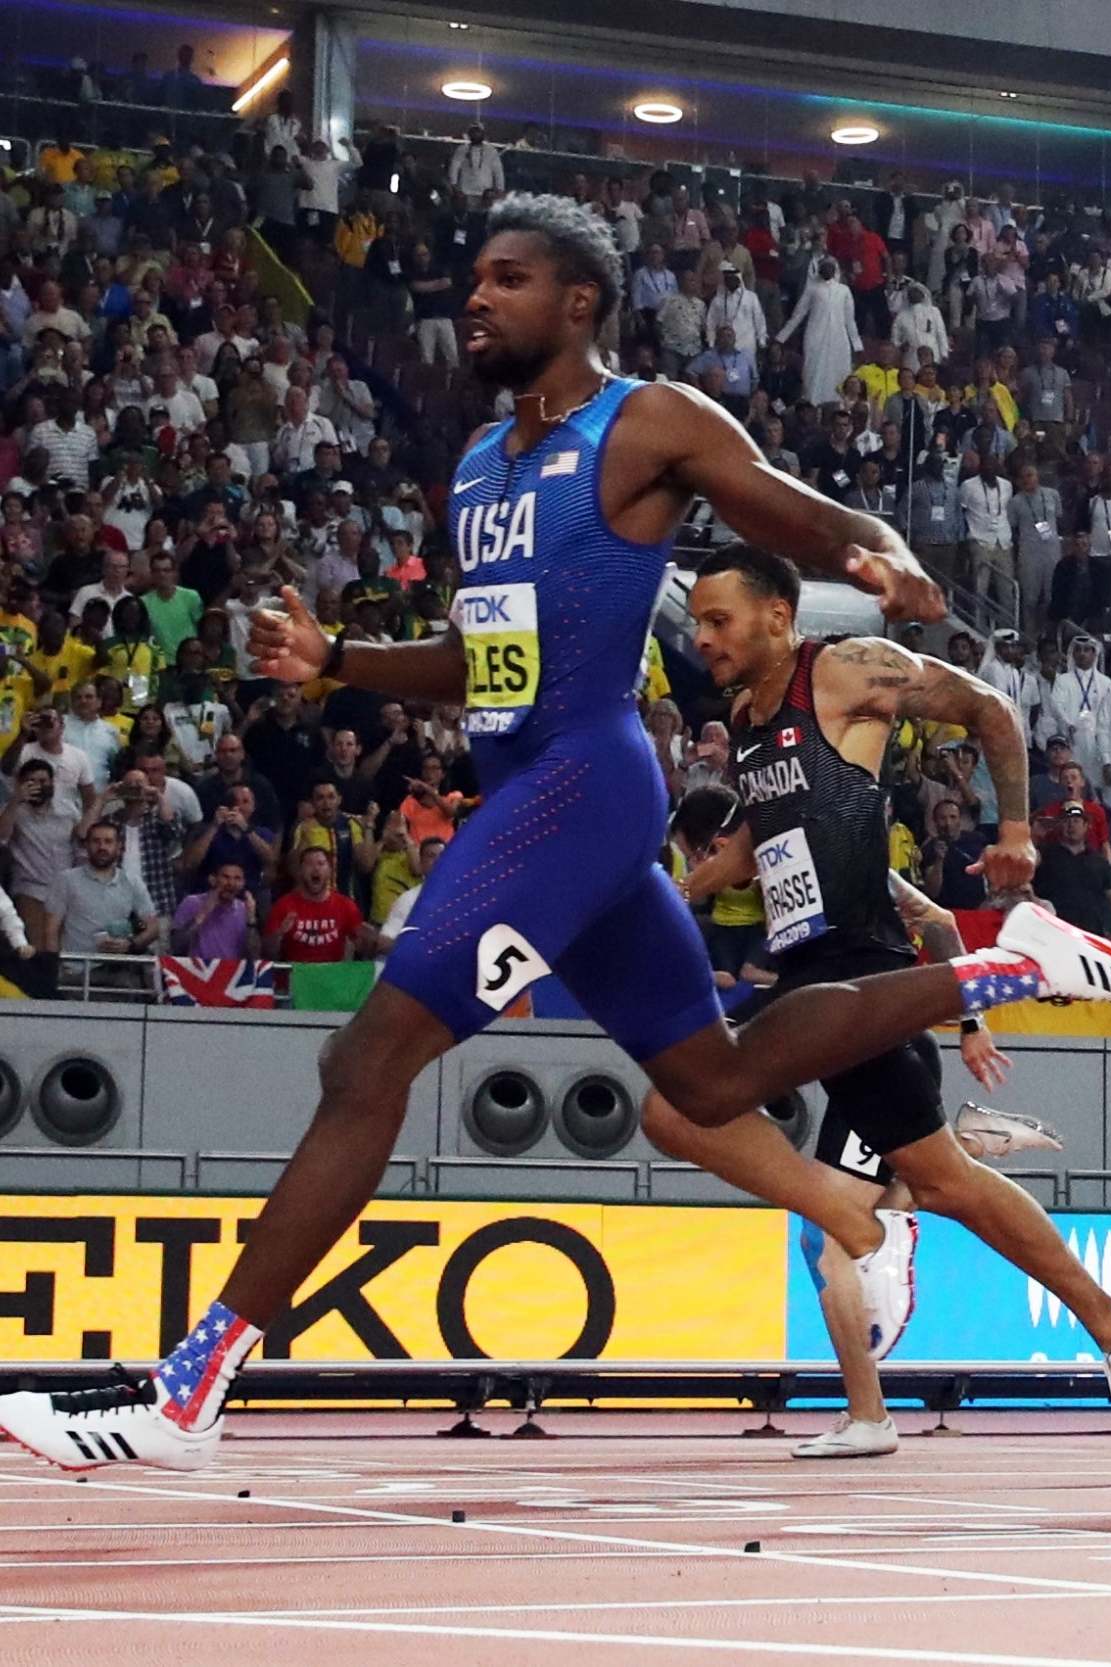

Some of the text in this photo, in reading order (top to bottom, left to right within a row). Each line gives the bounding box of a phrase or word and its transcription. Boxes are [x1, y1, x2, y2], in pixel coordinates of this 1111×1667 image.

[457, 491, 537, 573] USA
[463, 594, 512, 625] TDK
[738, 756, 811, 806] CANADA
[759, 839, 794, 871] TDK
[767, 870, 817, 921] RASSE
[483, 944, 531, 992] 5
